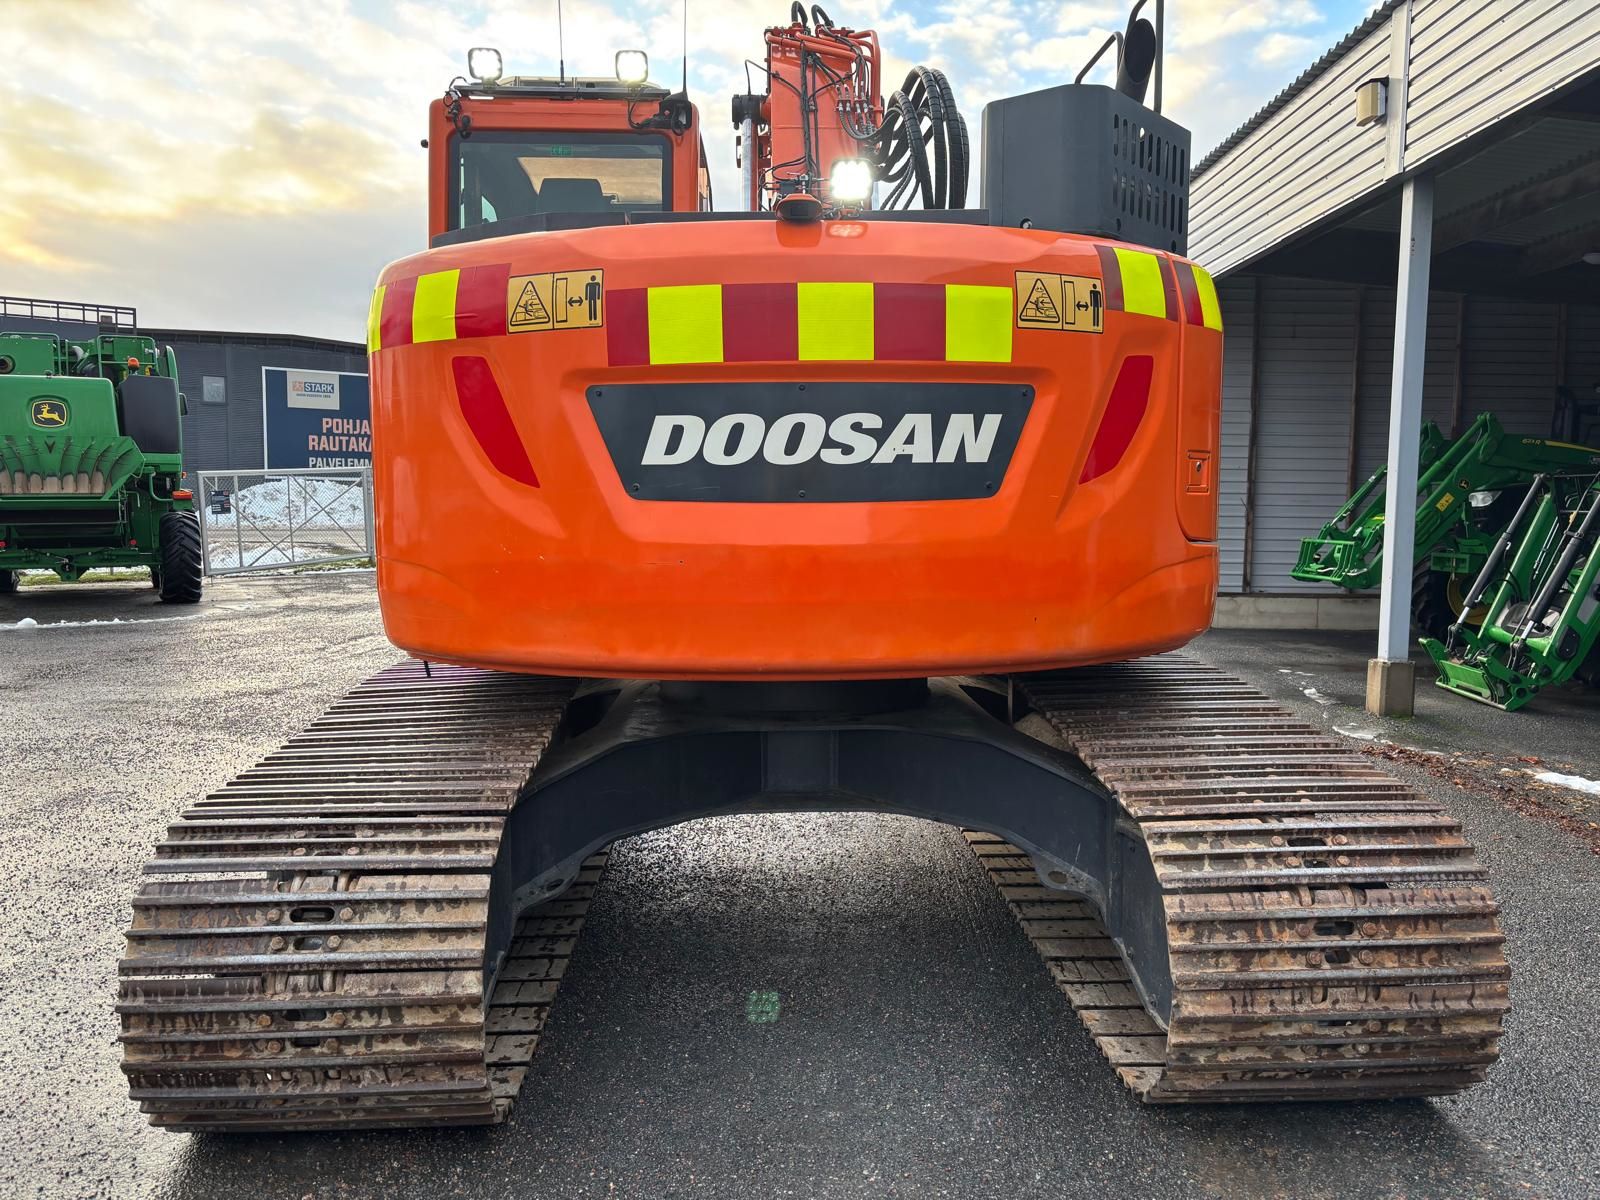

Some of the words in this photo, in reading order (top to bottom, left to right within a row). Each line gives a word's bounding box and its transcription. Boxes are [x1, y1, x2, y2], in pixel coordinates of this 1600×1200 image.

[304, 383, 334, 393] STARK
[322, 417, 371, 434] POHJA
[640, 412, 1003, 466] DOOSAN
